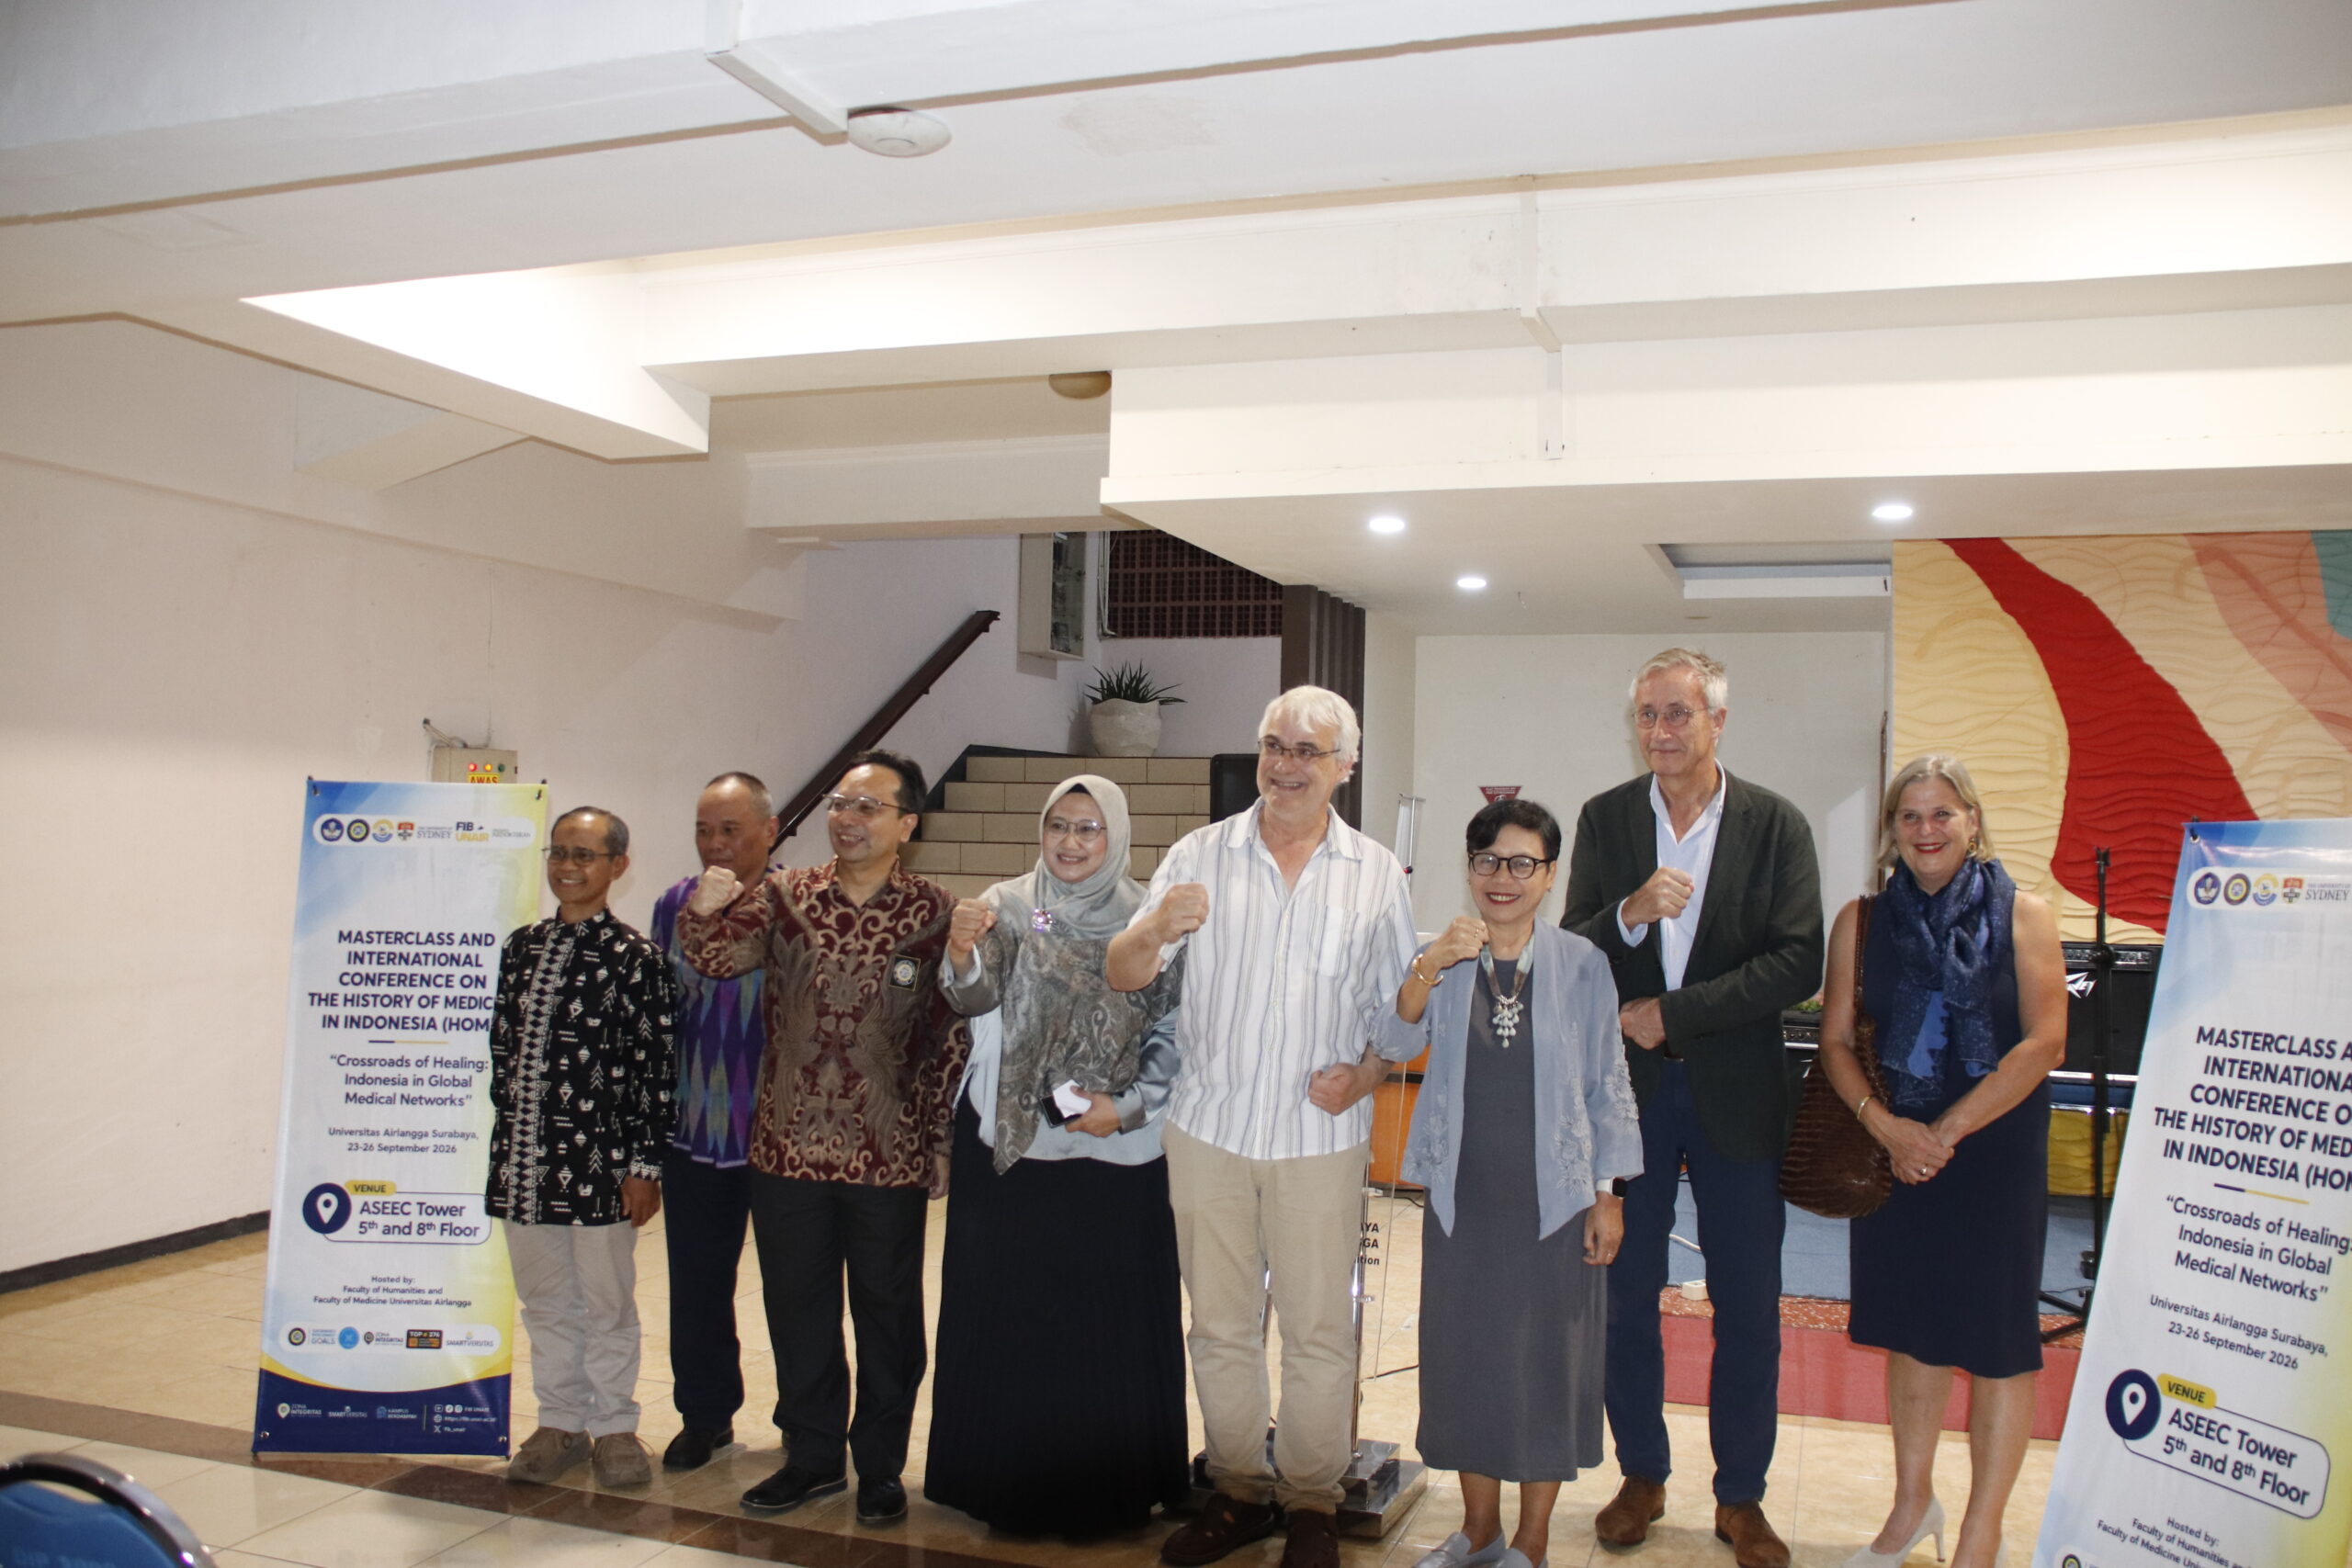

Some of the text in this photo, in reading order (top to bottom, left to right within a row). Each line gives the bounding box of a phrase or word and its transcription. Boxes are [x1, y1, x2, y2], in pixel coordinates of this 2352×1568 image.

[417, 830, 451, 839] SYDNEY
[456, 822, 474, 831] FIB
[2305, 888, 2351, 901] SYDNEY
[338, 930, 495, 947] MASTERCLASS AND
[347, 951, 483, 967] INTERNATIONAL
[338, 972, 487, 989] CONFERENCE ON
[309, 993, 493, 1010] THE HISTORY OF MEDIC
[322, 1015, 490, 1033] IN INDONESIA (HOM
[2196, 1026, 2337, 1059] MASTERCLASS
[330, 1054, 489, 1072] “Crossroads of Healing:
[345, 1074, 472, 1088] Indonesia in Global
[345, 1093, 472, 1107] Medical Networks”
[2190, 1084, 2352, 1125] CONFERENCE O
[328, 1127, 480, 1141] Universitas Airlangga Surabaya,
[2154, 1107, 2352, 1157] THE HISTORY OF MED
[347, 1143, 457, 1155] 23-26 September 2026
[2163, 1139, 2184, 1160] IN
[2188, 1144, 2300, 1182] INDONESIA
[354, 1184, 387, 1193] VENUE
[359, 1201, 466, 1216] ASEEC Tower
[2166, 1195, 2260, 1231] “Crossroads
[2266, 1218, 2285, 1235] of
[358, 1221, 480, 1237] 5th and 8th Floor
[1361, 1222, 1379, 1233] YA
[1360, 1237, 1379, 1249] GA
[2178, 1224, 2333, 1276] Indonesia in Global
[401, 1276, 415, 1285] by:
[2175, 1250, 2328, 1302] Medical Networks”
[343, 1286, 370, 1295] Faculty
[372, 1286, 380, 1294] of
[382, 1286, 426, 1294] Humanities
[313, 1296, 471, 1308] Faculty of Medicine Universitas Airlangga
[2150, 1294, 2328, 1357] Universitas Airlangga Surabaya,
[311, 1337, 335, 1345] GOALS
[2168, 1321, 2299, 1370] 23-26 September 2026
[2167, 1381, 2206, 1404] VENUE
[2167, 1407, 2298, 1469] ASEEC Tower
[2163, 1435, 2311, 1506] 5th and 8th Floor
[2098, 1519, 2128, 1542] Faculty
[2130, 1534, 2139, 1544] of
[2140, 1540, 2181, 1563] Medicine
[2166, 1517, 2220, 1548] Hosted by:
[2132, 1517, 2230, 1567] Faculty of Humanities
